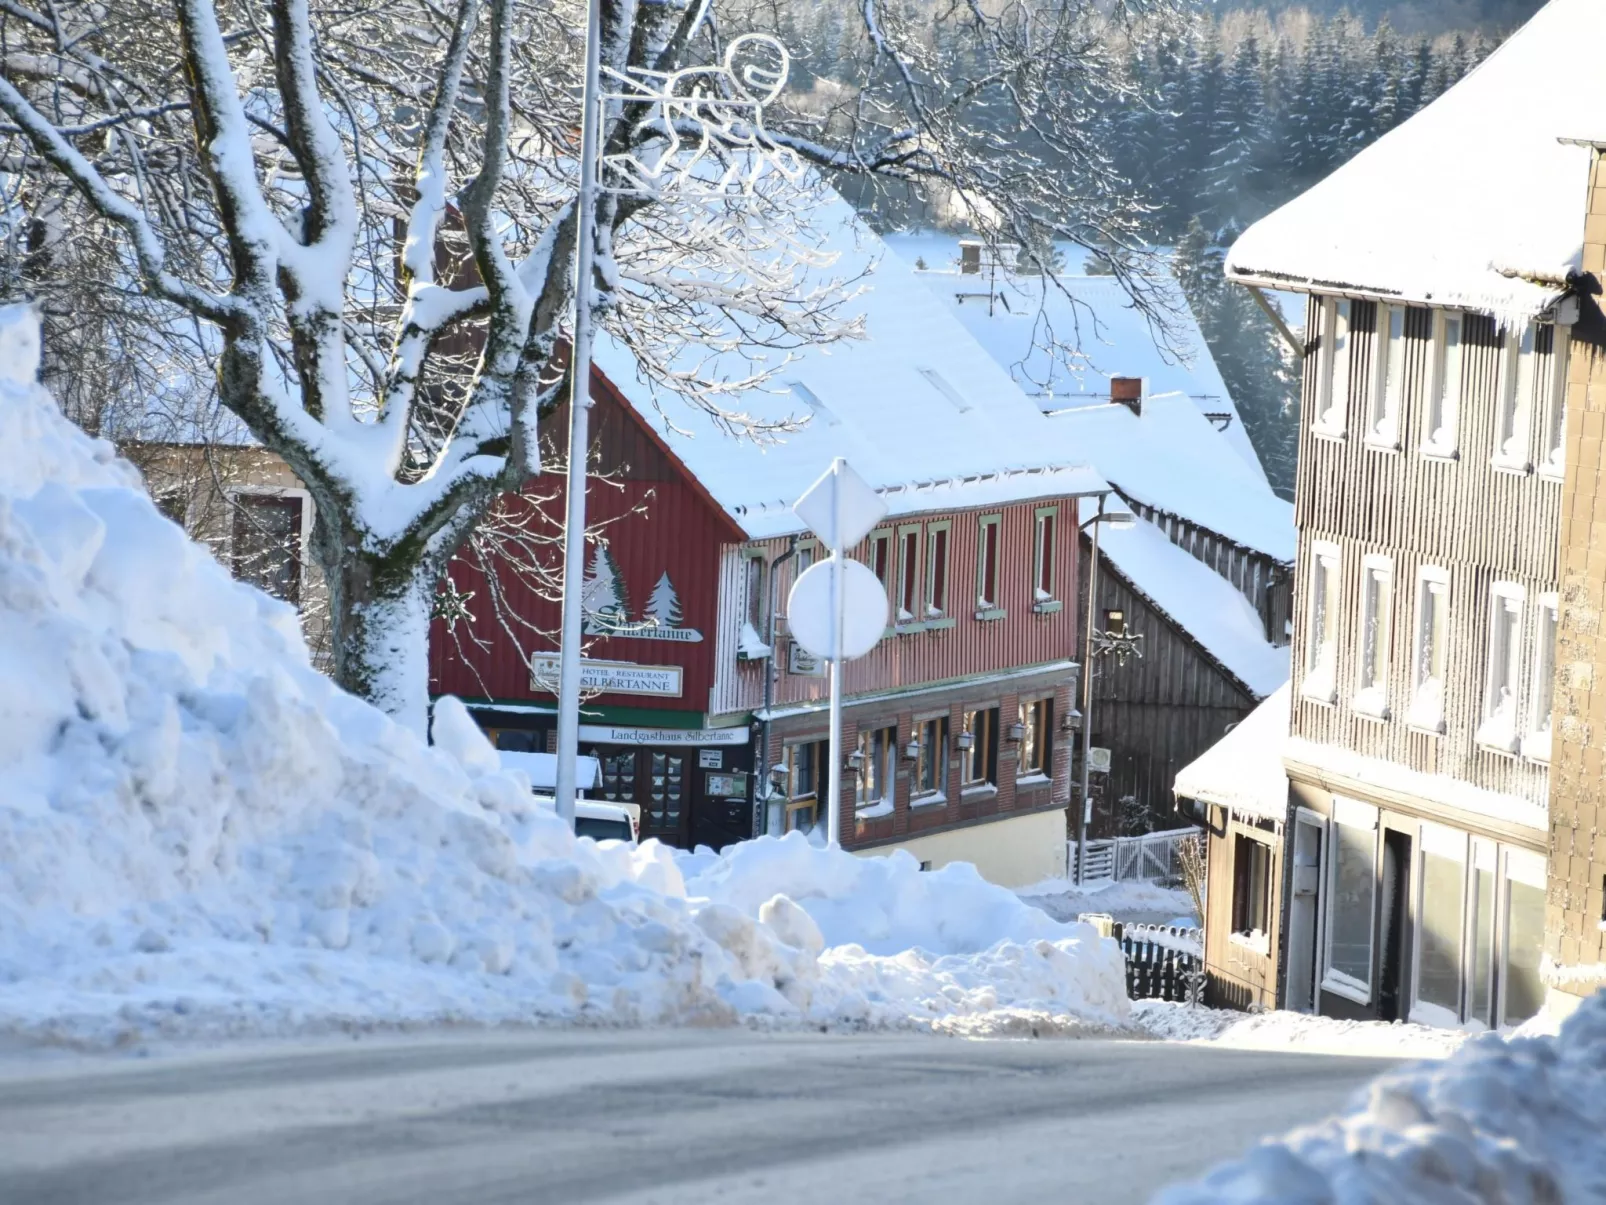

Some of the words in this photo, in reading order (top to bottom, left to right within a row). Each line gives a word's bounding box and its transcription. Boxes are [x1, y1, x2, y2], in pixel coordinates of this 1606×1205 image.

[582, 667, 610, 677] HOTEL
[616, 670, 670, 681] RESTAURANT
[581, 676, 671, 691] SILBERTANNE
[611, 729, 682, 744] Landgasthaus
[684, 730, 734, 743] Silbertanne
